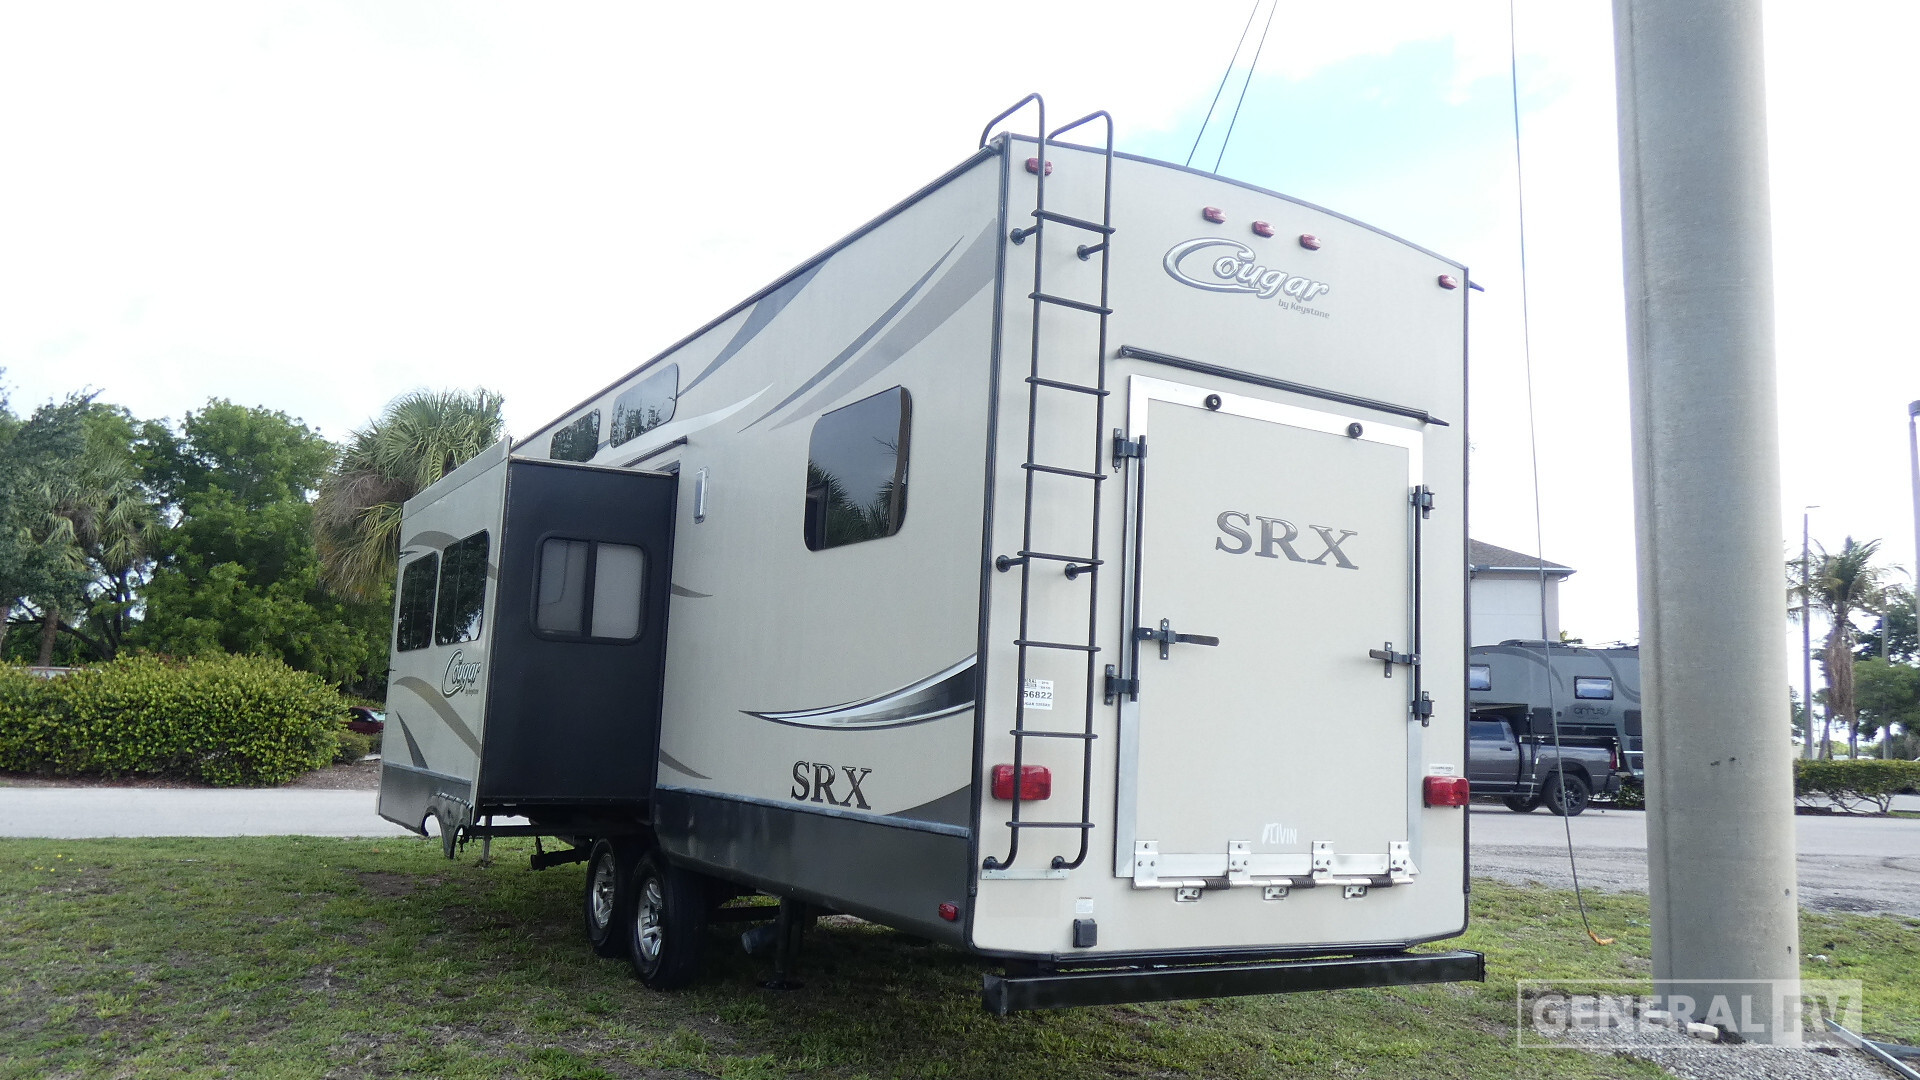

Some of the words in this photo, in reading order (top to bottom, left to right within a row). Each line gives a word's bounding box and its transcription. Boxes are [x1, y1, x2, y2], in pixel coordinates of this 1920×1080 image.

[1163, 237, 1330, 303] Cougar
[1278, 299, 1289, 310] by
[1290, 302, 1330, 319] Keystone
[1215, 510, 1360, 571] SRX
[442, 649, 481, 698] Cougar
[1023, 690, 1053, 700] 56822
[791, 760, 872, 811] SRX
